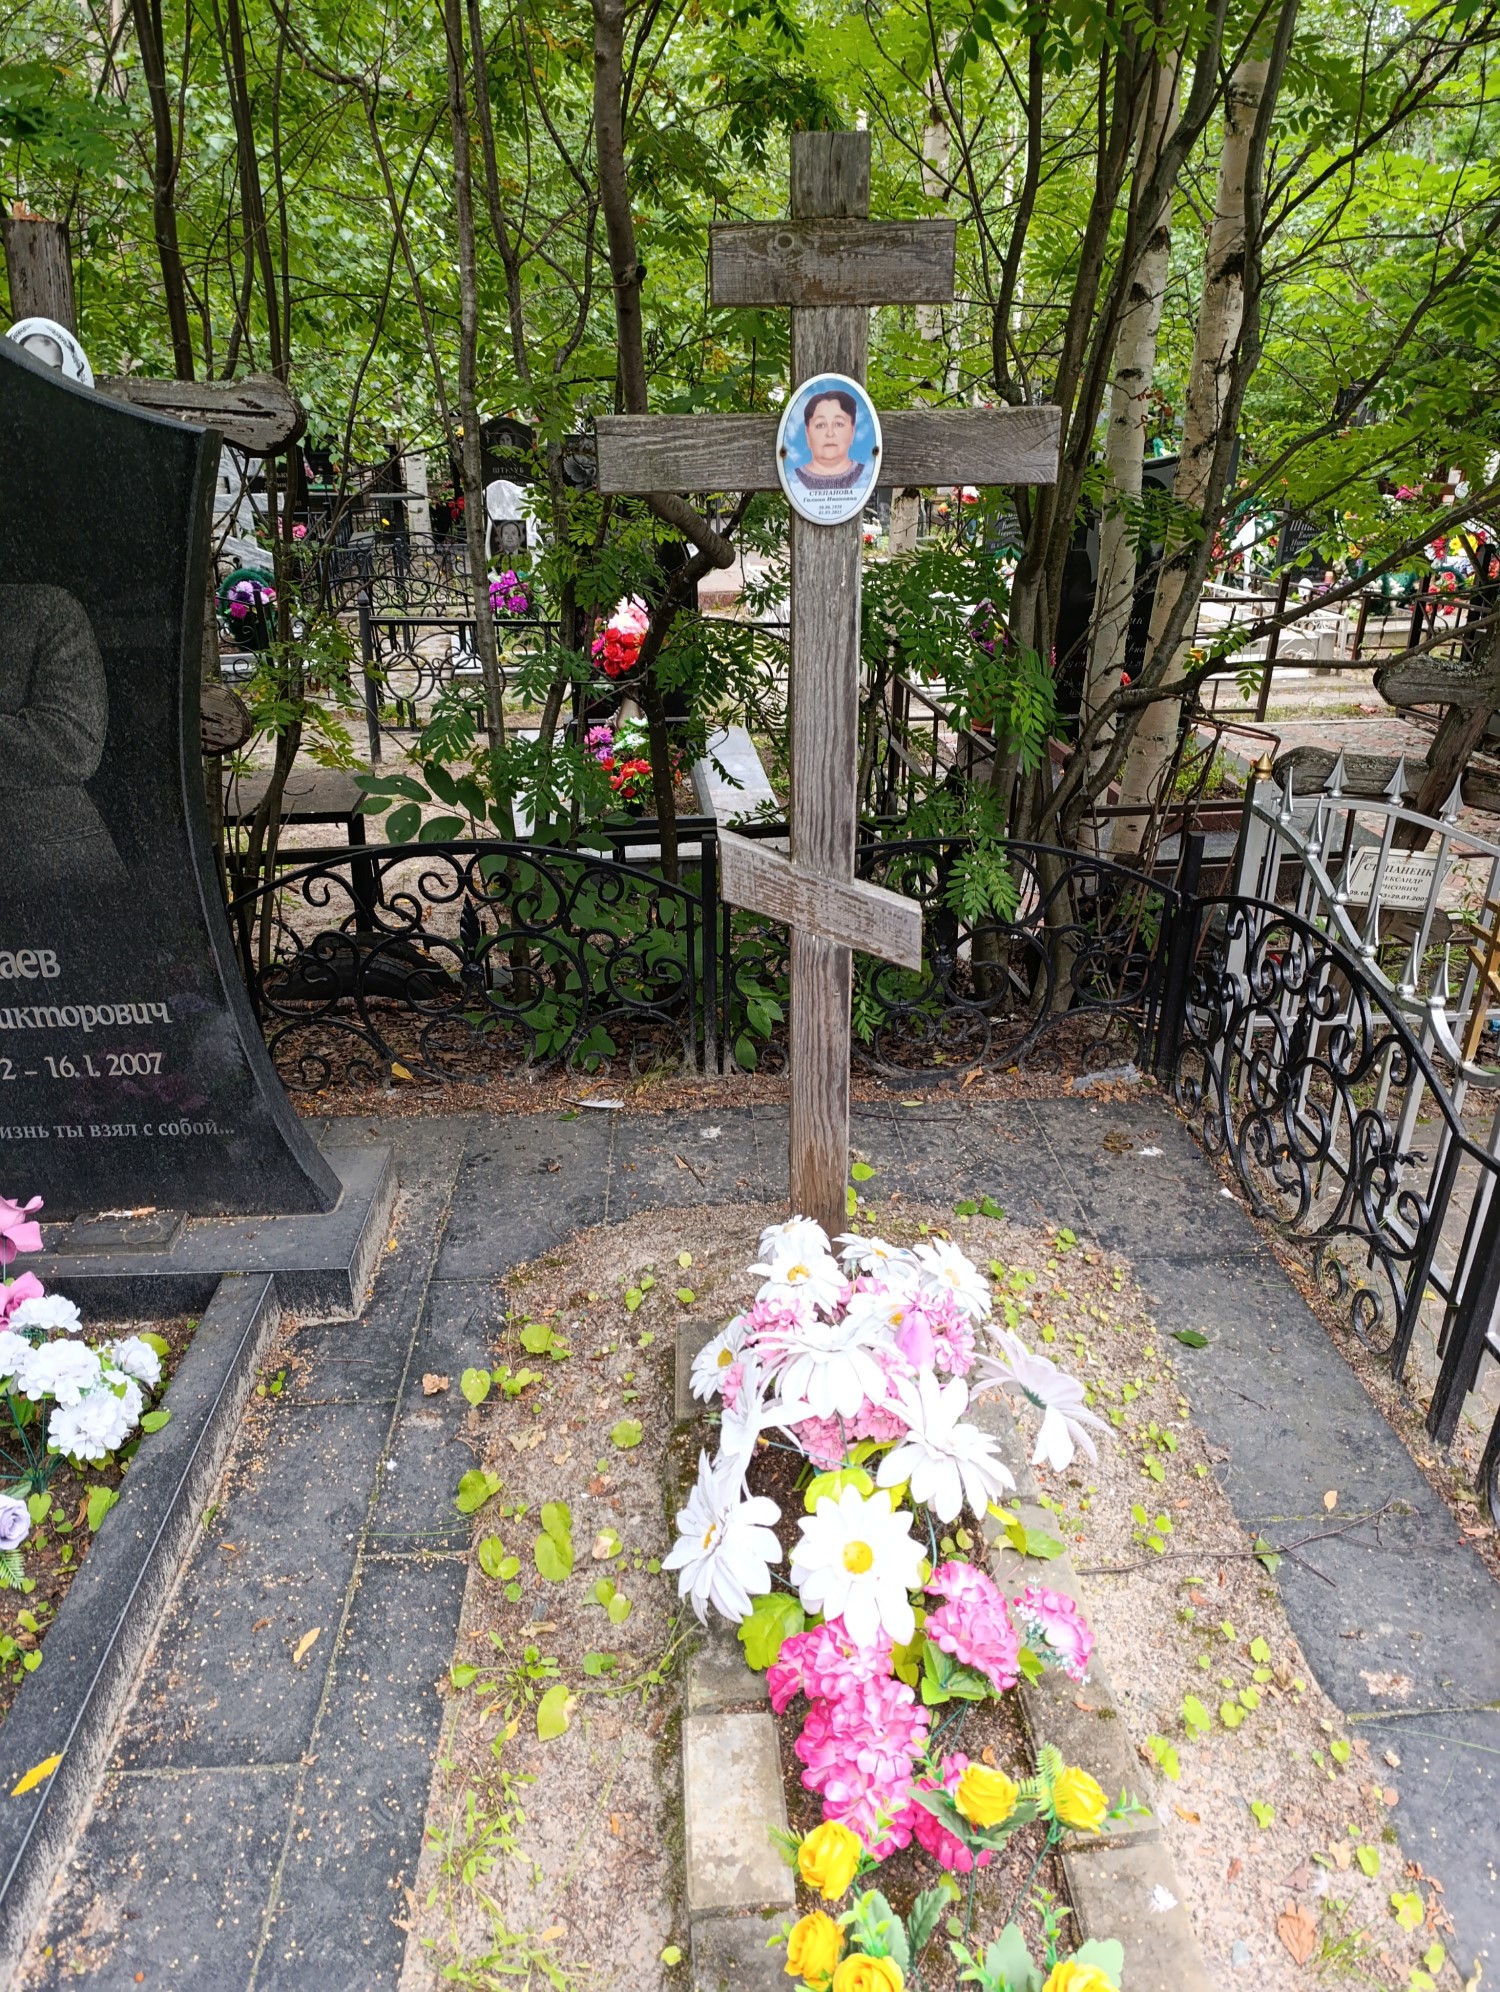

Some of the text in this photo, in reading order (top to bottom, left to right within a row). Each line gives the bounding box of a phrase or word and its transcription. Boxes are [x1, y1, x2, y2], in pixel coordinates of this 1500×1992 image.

[1364, 863, 1435, 877] СТПАНЕНК
[1384, 875, 1423, 884] ЕКСАНДР
[1368, 882, 1419, 892] РИСОВИЧ
[0, 949, 61, 979] аев
[53, 1125, 84, 1139] ты
[89, 1123, 138, 1138] взял
[143, 1123, 154, 1137] с
[158, 1118, 235, 1137] собой...
